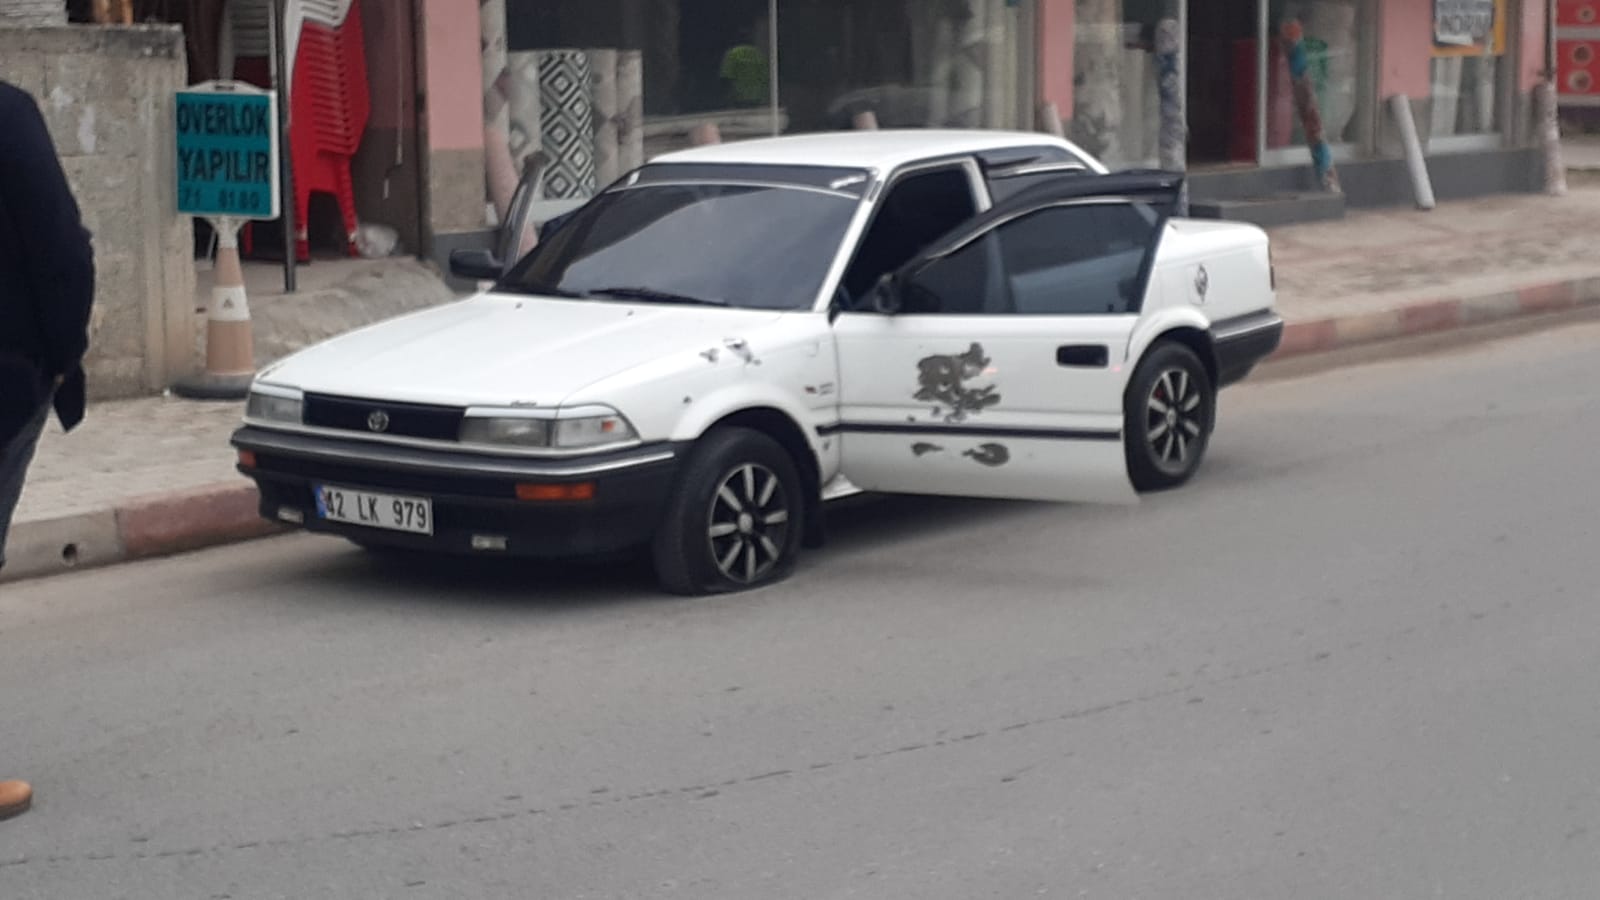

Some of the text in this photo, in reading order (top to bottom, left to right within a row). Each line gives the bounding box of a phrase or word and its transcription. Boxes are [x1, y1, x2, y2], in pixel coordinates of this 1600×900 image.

[177, 103, 269, 137] OVERLOK
[178, 148, 269, 183] YAPILIR
[326, 490, 427, 529] 42 LK 979
